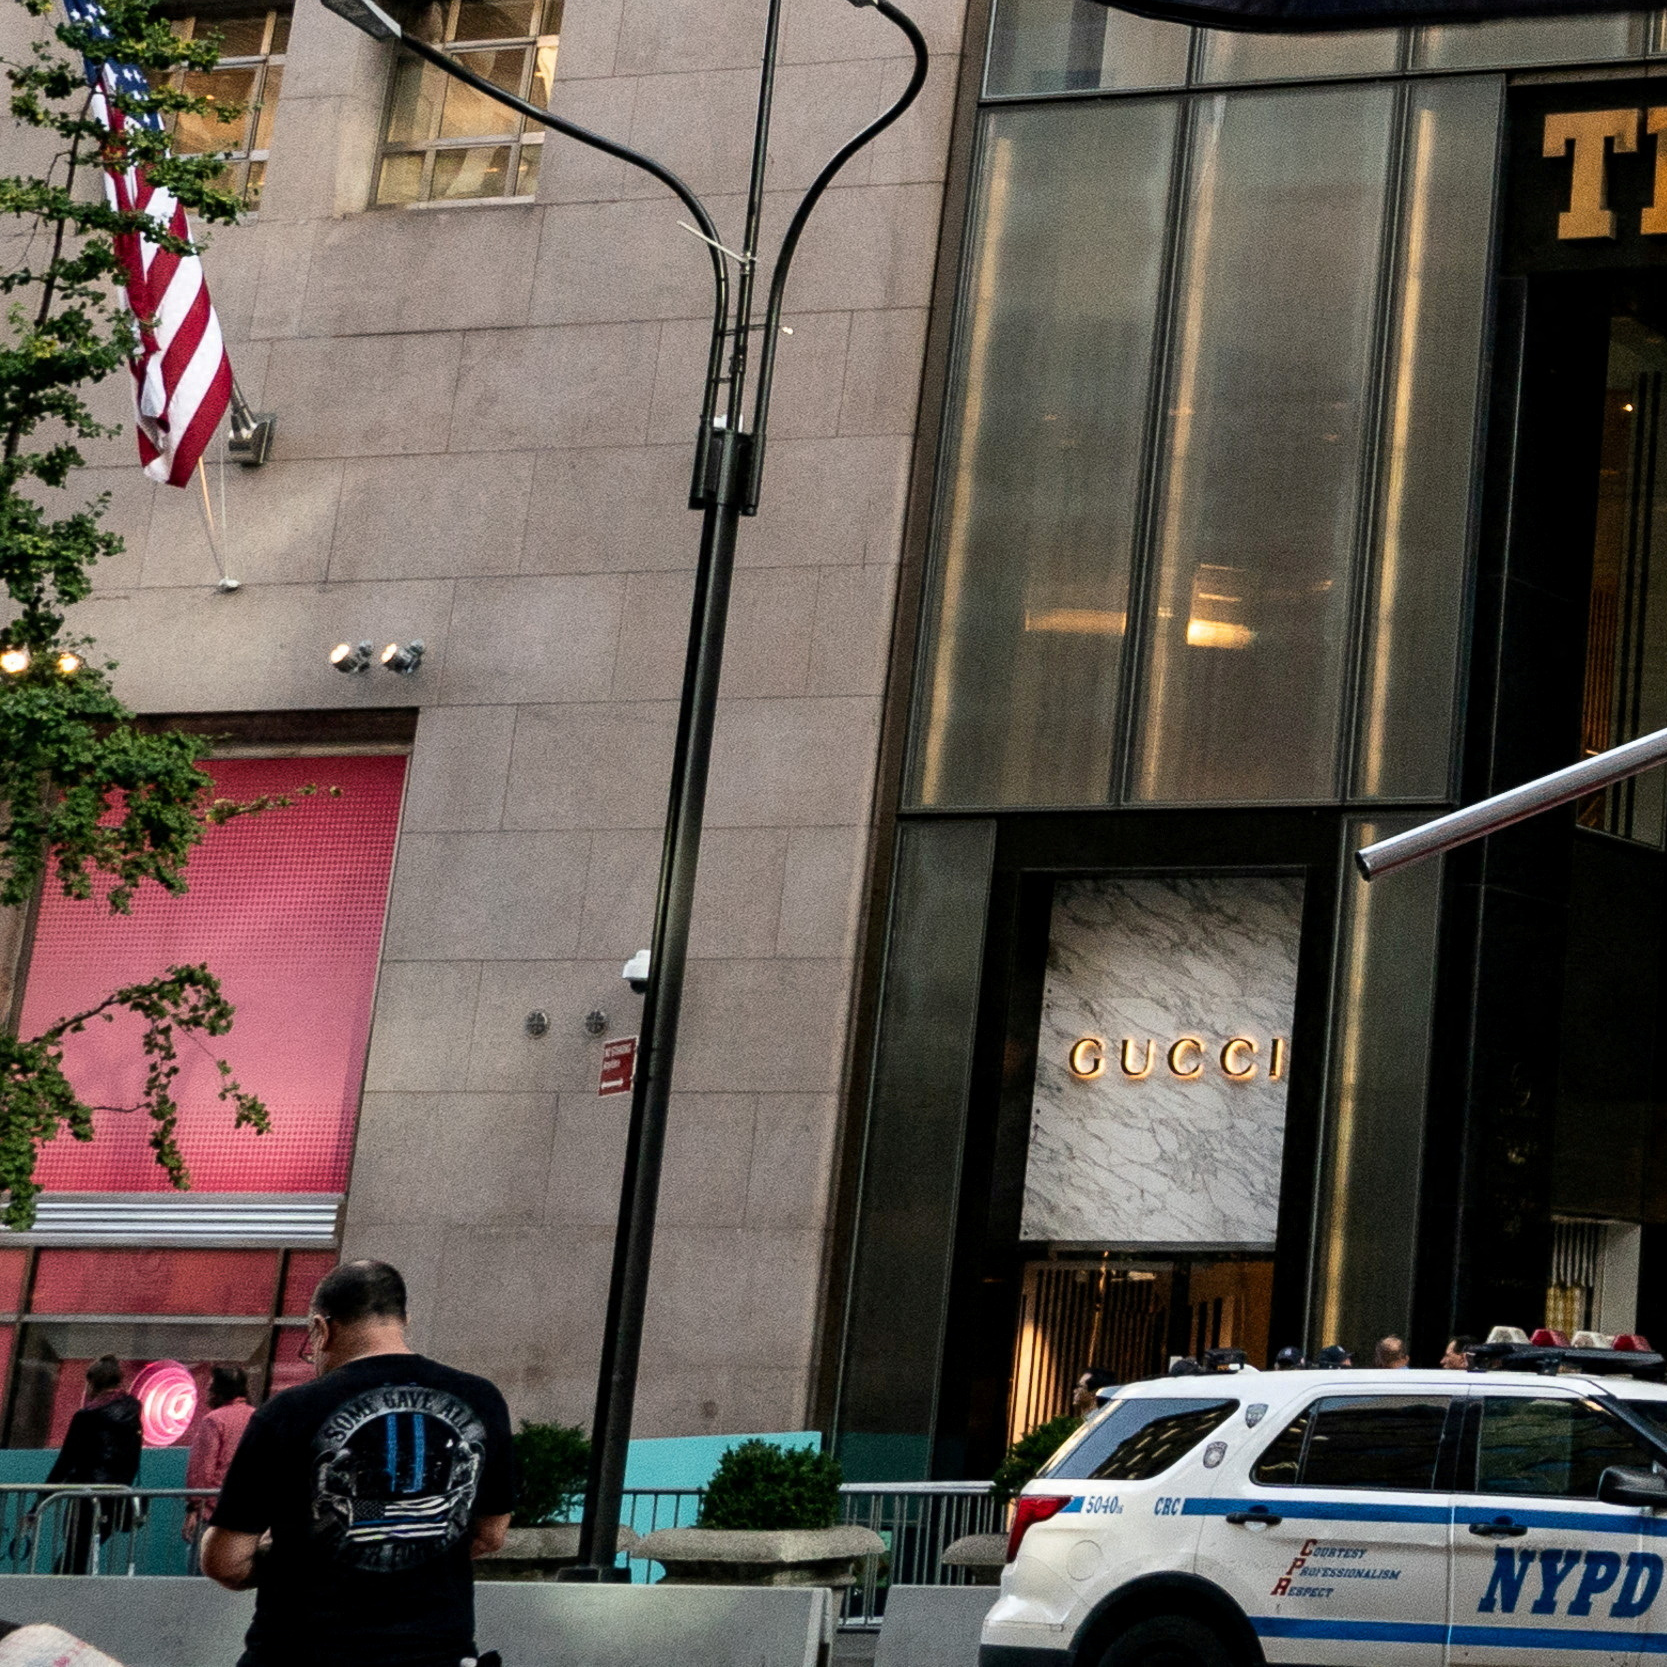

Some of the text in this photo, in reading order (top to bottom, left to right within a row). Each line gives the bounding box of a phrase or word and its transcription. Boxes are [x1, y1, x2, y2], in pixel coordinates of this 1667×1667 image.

[1068, 1037, 1287, 1078] GUCCI
[324, 1389, 473, 1441] SOME GAVE ALL
[1086, 1495, 1119, 1514] 5040
[1154, 1497, 1182, 1516] CRC
[1300, 1538, 1368, 1559] COURTESY
[1286, 1557, 1402, 1580] PROFESSIONALISM
[1270, 1577, 1335, 1598] RESPECT
[1477, 1546, 1665, 1618] NYPD
